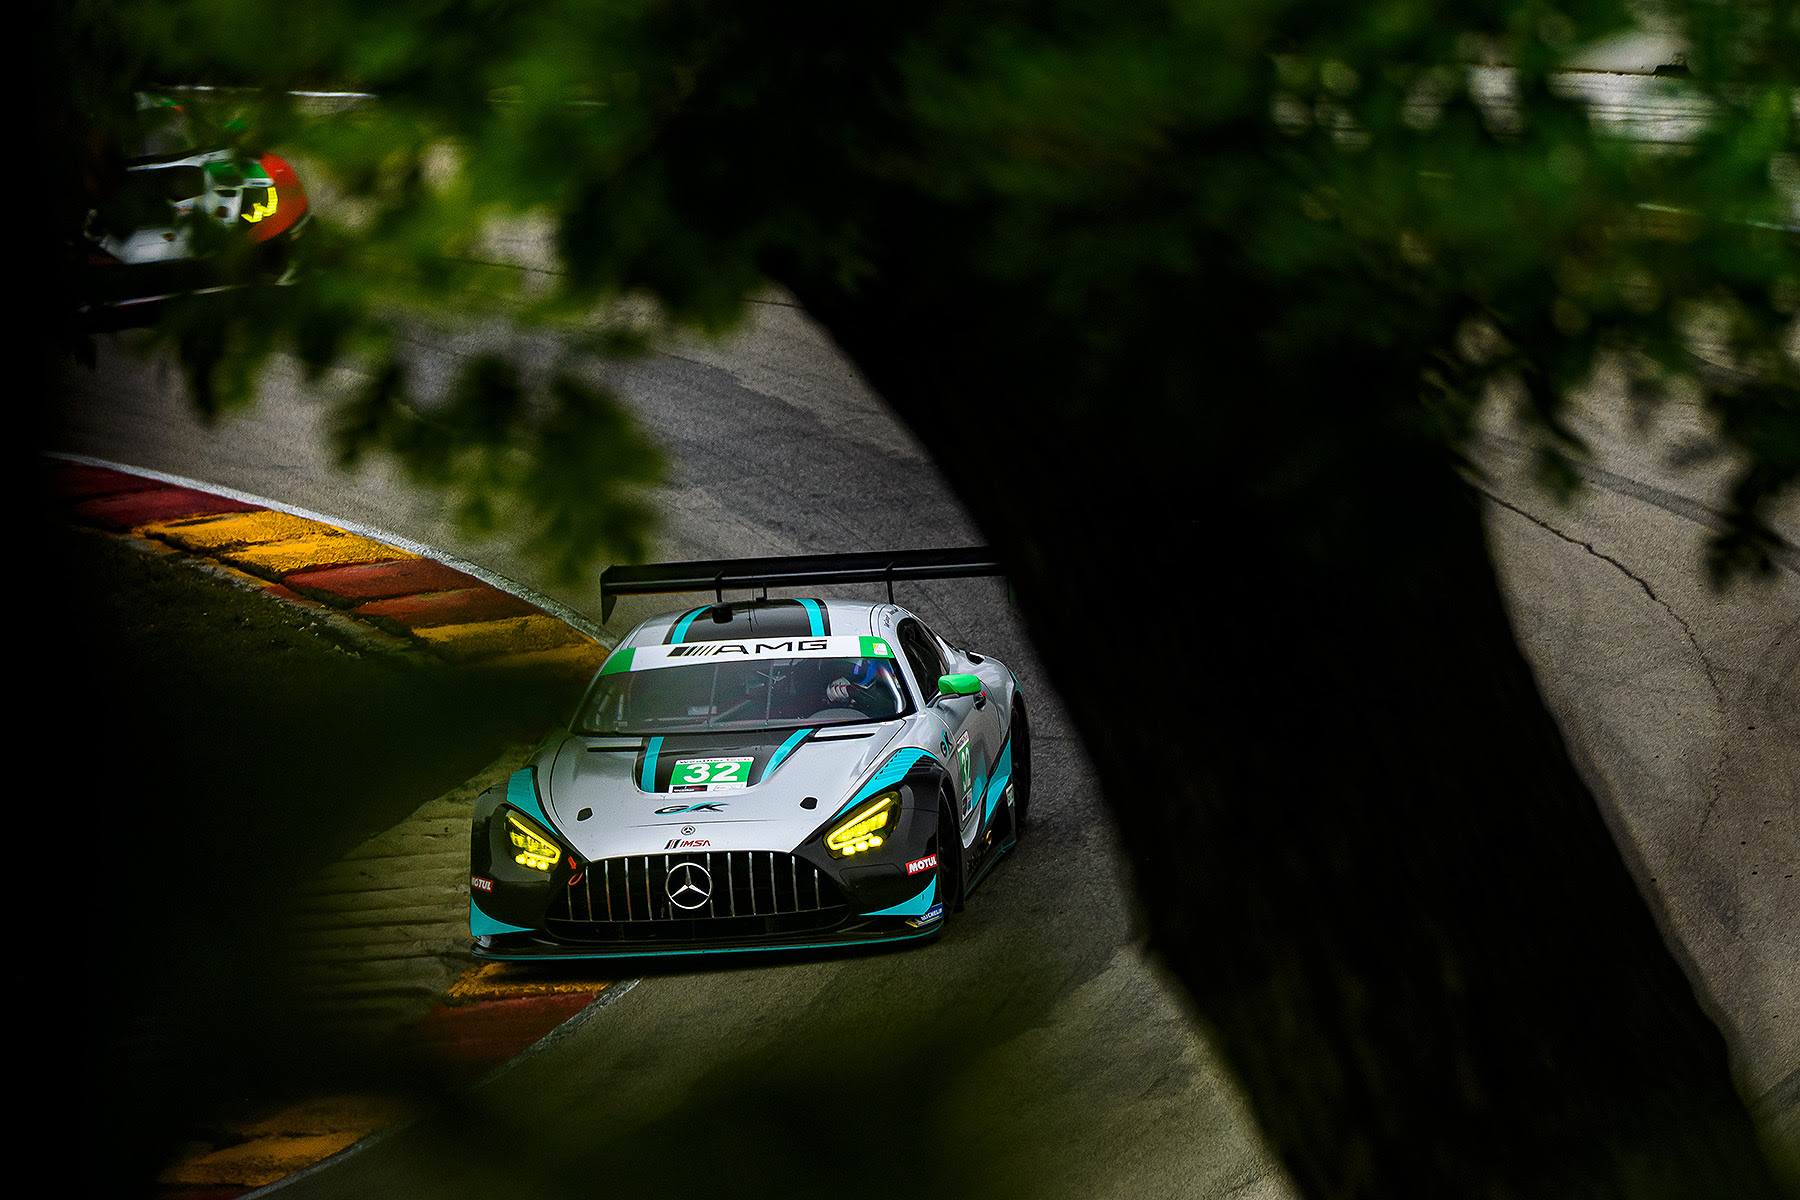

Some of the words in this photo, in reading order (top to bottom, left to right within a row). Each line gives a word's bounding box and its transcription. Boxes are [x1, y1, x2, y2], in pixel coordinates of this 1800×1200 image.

[712, 639, 828, 656] AMG
[683, 762, 741, 783] 32
[679, 839, 712, 849] IMSA
[908, 856, 937, 874] MOTUL
